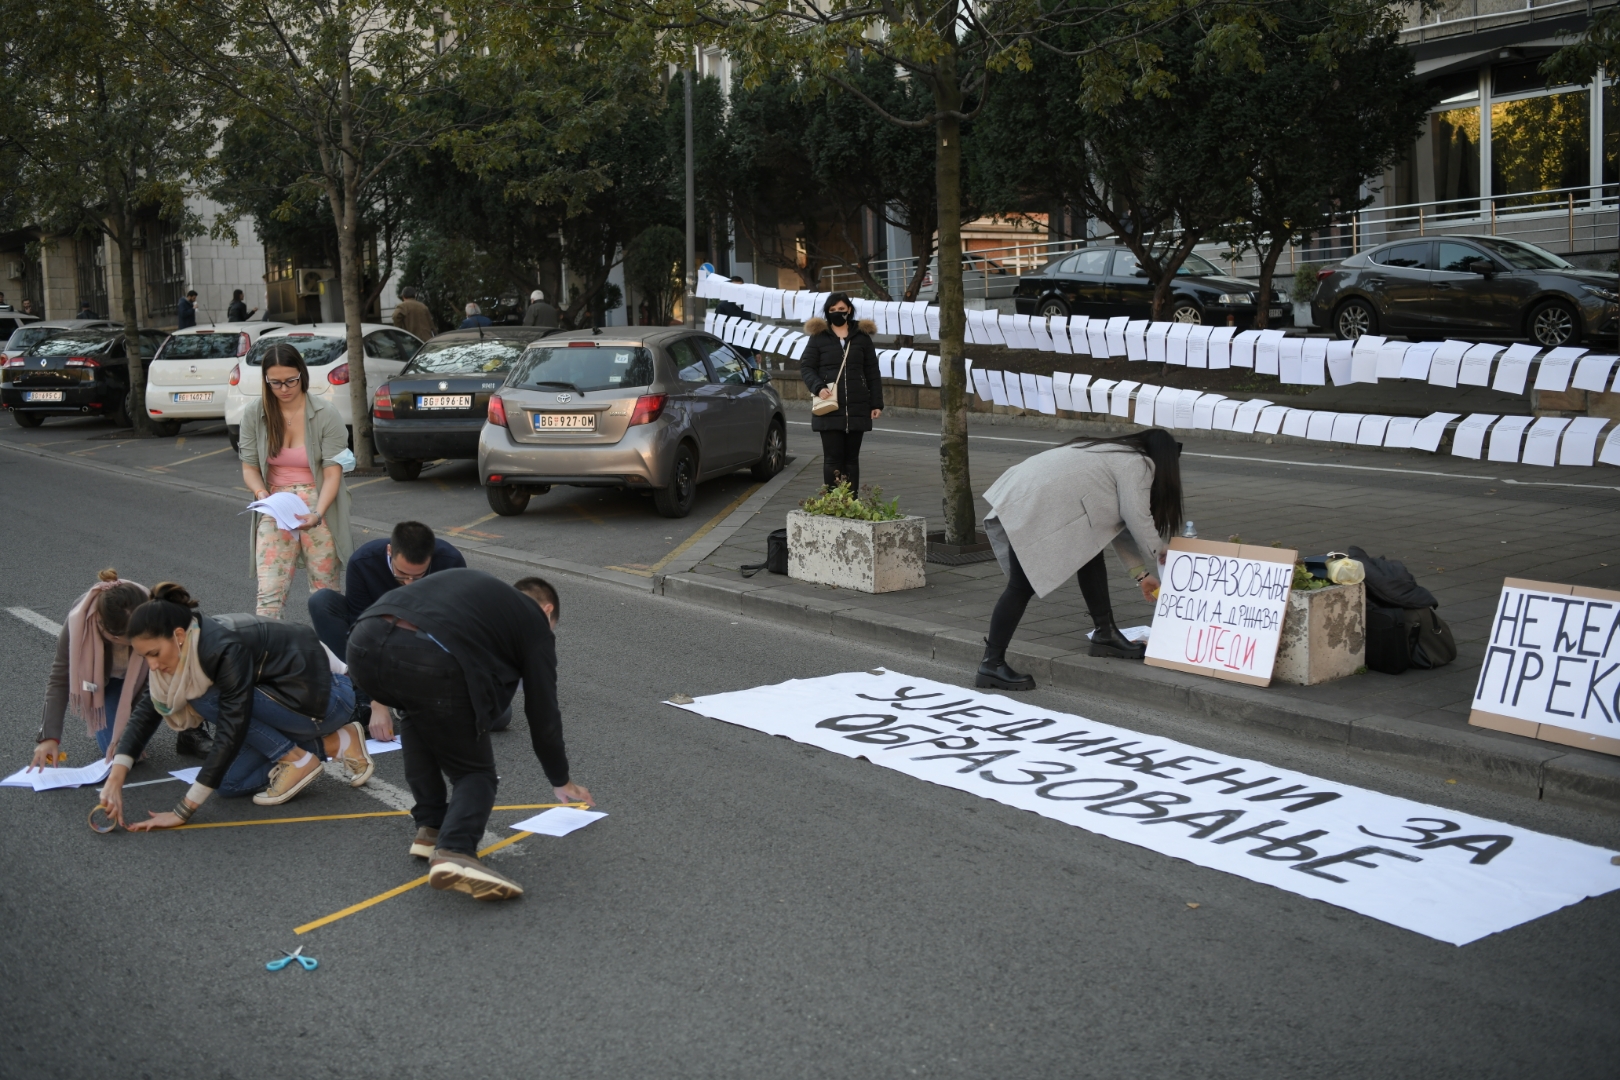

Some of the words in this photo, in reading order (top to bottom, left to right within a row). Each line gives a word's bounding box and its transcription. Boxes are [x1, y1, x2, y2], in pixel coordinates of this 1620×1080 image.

[423, 397, 434, 406] BG
[541, 416, 553, 427] BG
[1170, 554, 1292, 603] ОБРАЗОВАЊЕ
[1209, 600, 1222, 624] А
[1222, 604, 1279, 631] ДРЖАВА
[1184, 625, 1257, 671] ШТЕДИ
[1476, 645, 1620, 724] ПРЕК
[814, 713, 1424, 884] ОБРАЗОВАЊЕ
[855, 686, 1343, 813] УЈЕДИЊЕНИ
[1357, 817, 1514, 866] ЗА
